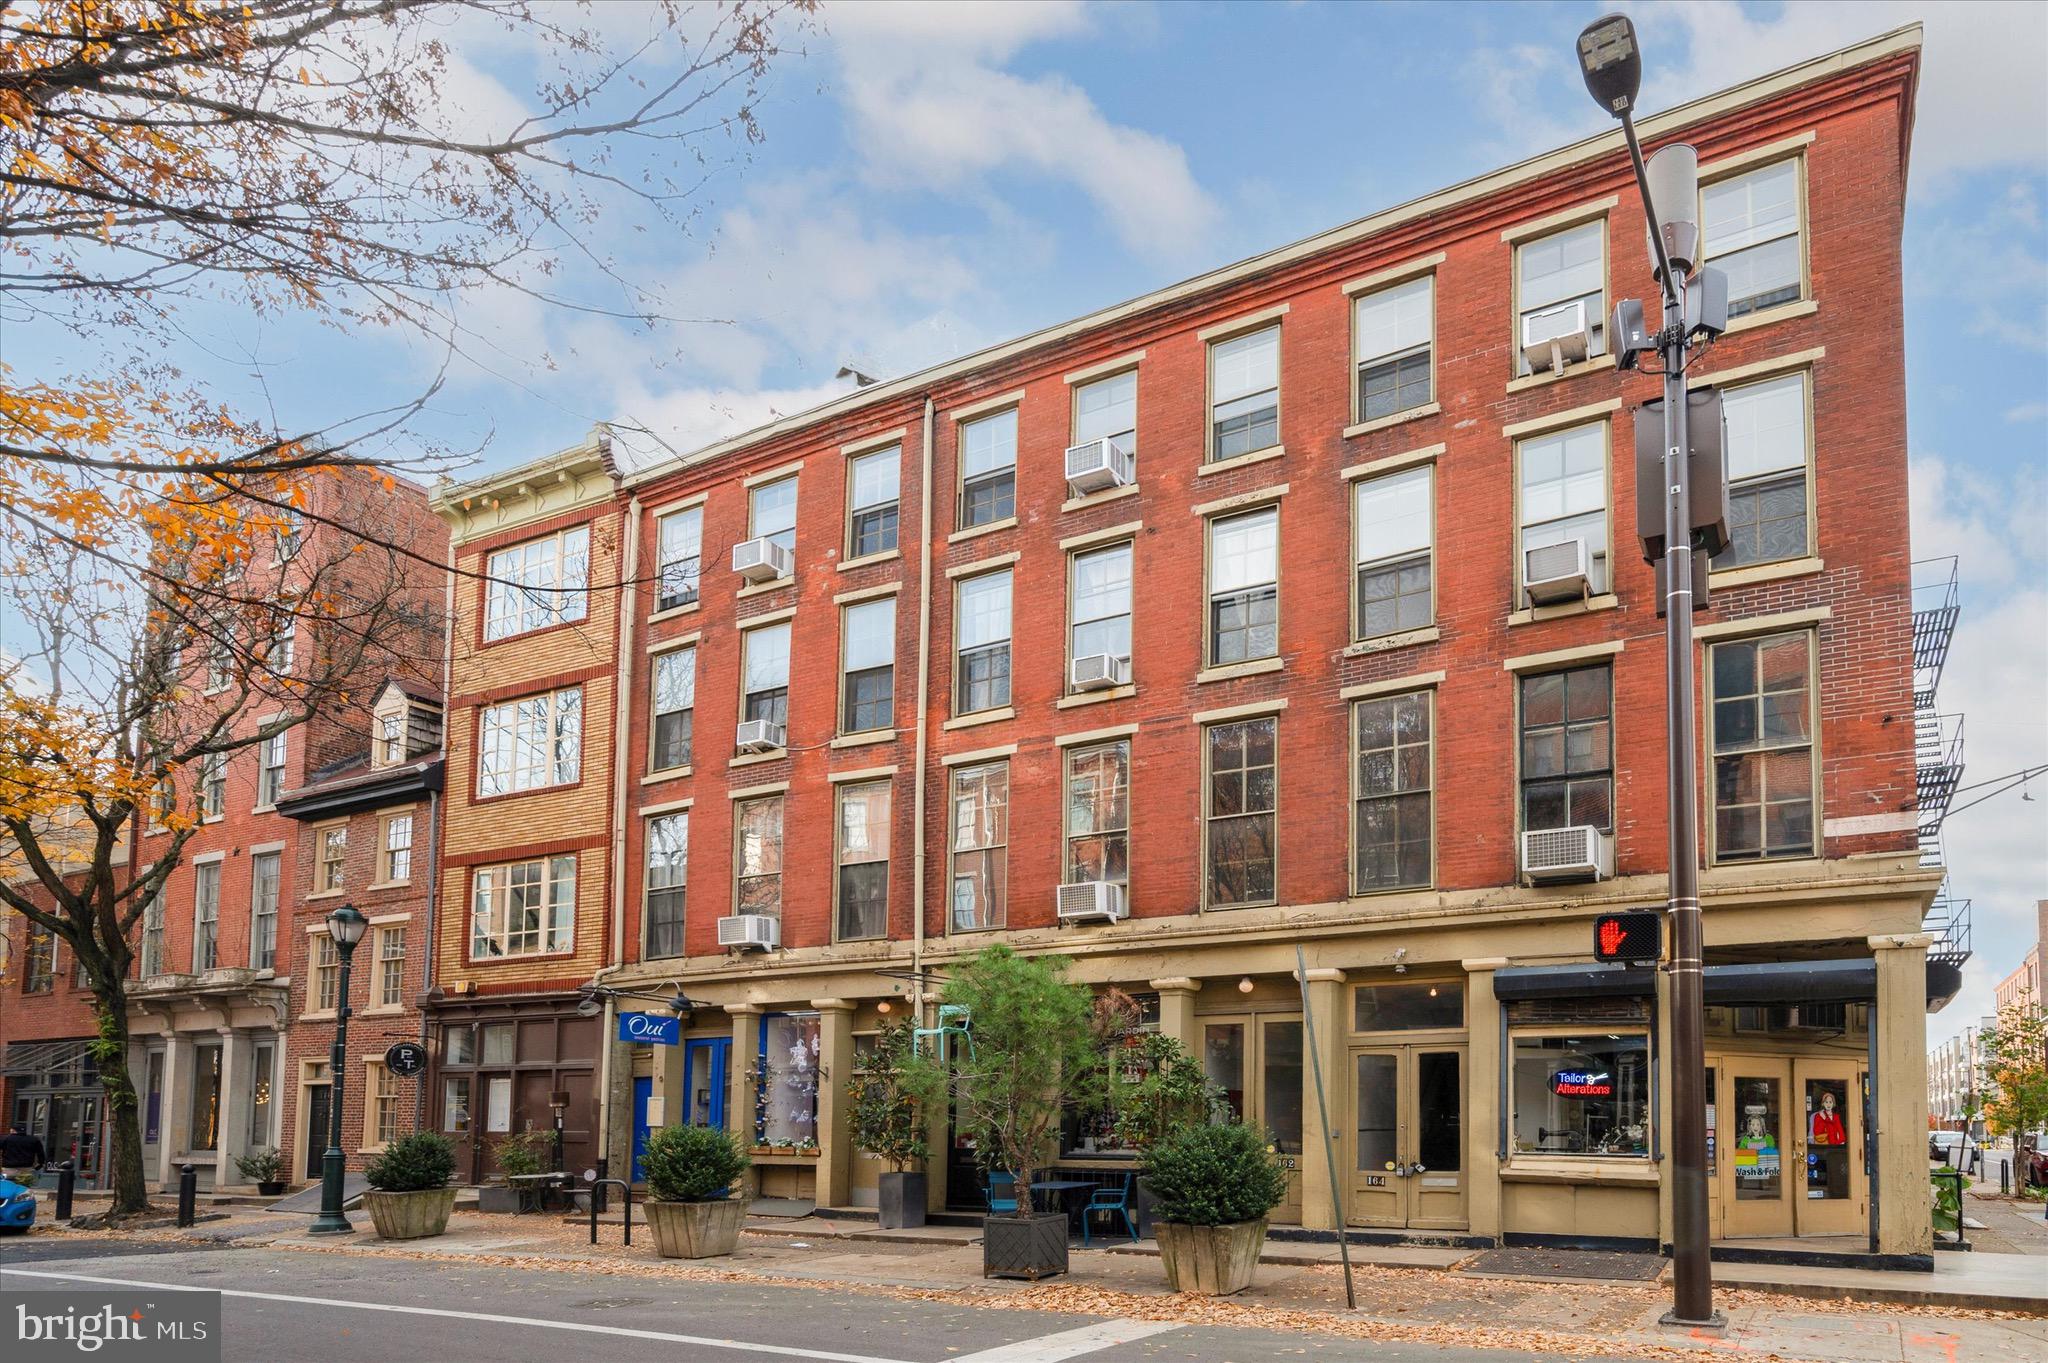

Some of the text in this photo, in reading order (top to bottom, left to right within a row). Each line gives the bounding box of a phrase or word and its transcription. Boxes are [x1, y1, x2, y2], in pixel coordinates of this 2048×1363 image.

[1558, 1073, 1585, 1083] Tailor
[1556, 1083, 1610, 1094] Alterations
[1367, 1176, 1385, 1186] 164
